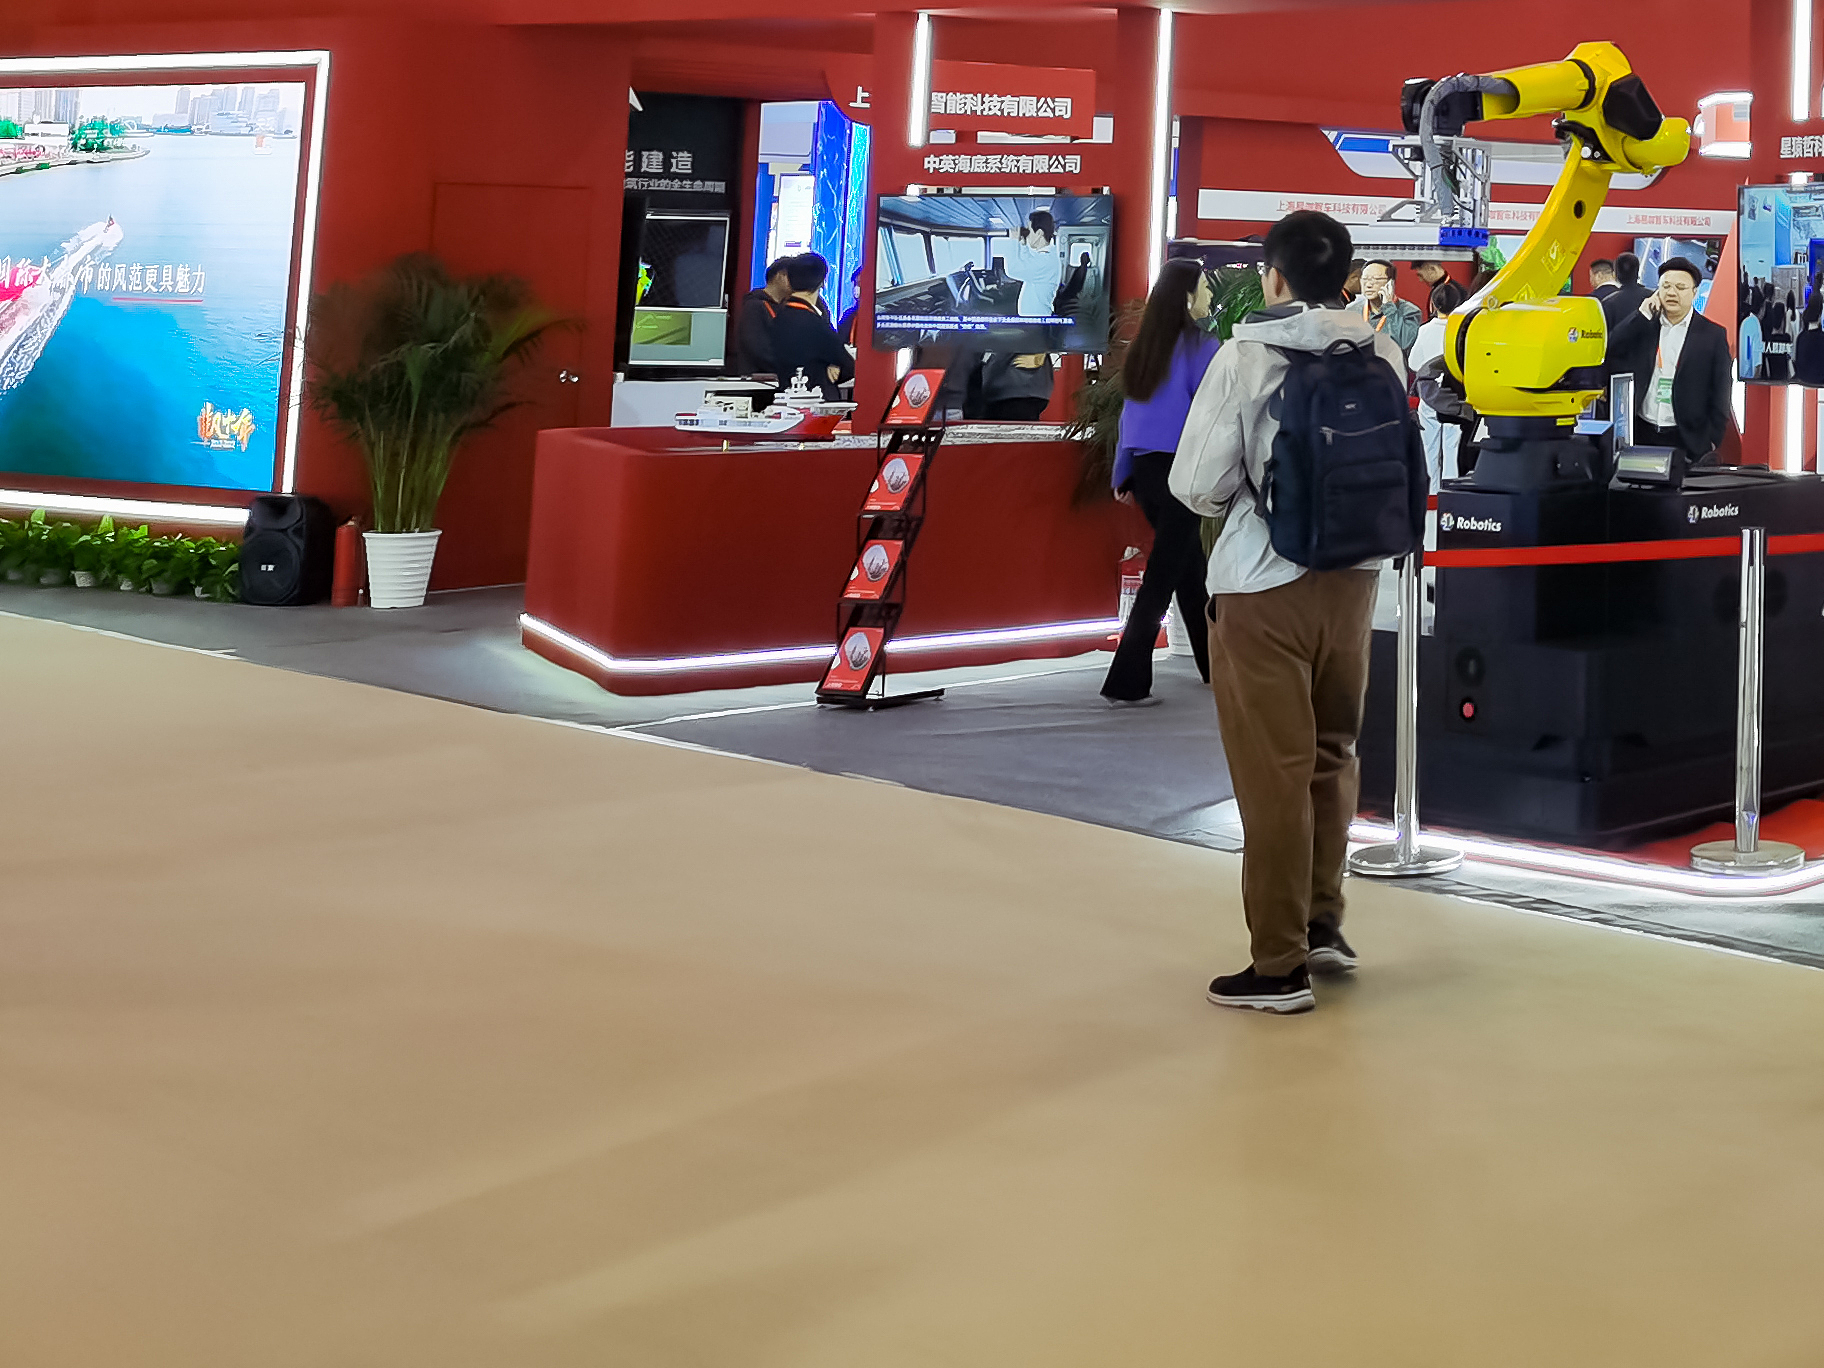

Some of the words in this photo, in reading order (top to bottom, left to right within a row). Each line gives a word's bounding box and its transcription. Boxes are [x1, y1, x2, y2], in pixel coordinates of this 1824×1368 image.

[924, 154, 1081, 173] 中英海底系统有限公司
[1701, 504, 1739, 519] Robotics
[1456, 516, 1502, 532] Robotics
